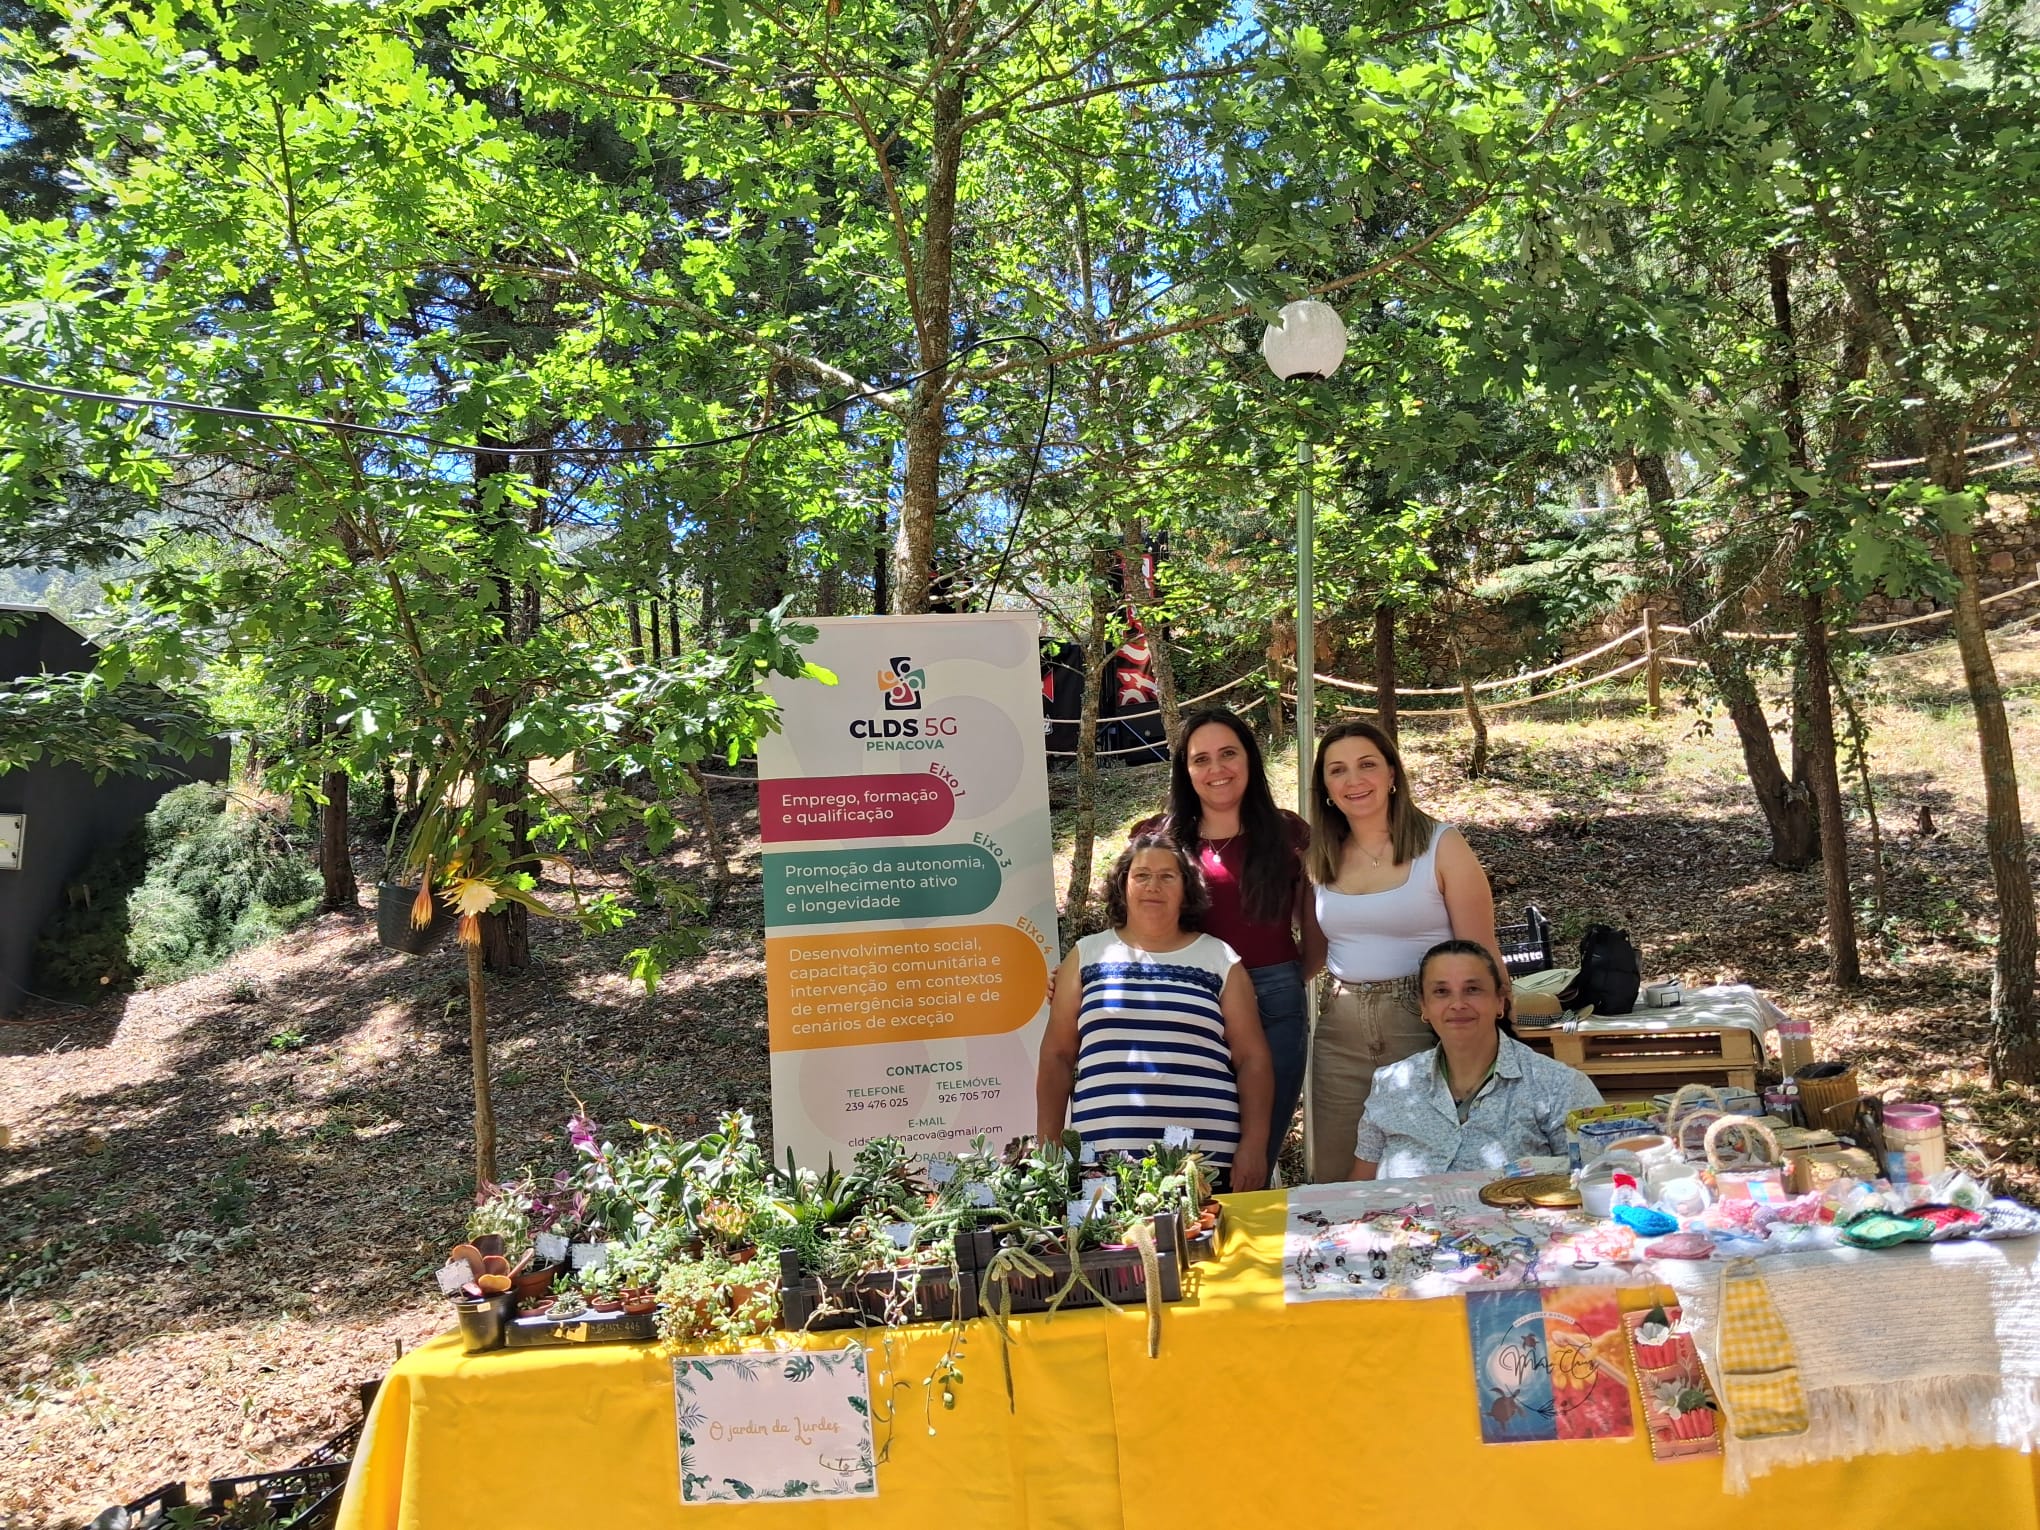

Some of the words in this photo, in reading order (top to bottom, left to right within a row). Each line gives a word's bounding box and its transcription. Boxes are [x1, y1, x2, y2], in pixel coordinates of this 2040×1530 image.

[850, 719, 918, 738] CLDS
[925, 717, 958, 736] 5G
[866, 739, 944, 752] PENACOVA
[929, 762, 959, 788] Eixo
[955, 790, 966, 798] 1
[782, 792, 860, 808] Emprego,
[864, 788, 938, 804] formação
[782, 814, 792, 824] e
[796, 807, 894, 826] qualificação
[973, 832, 1003, 857] Eixo
[1001, 858, 1012, 869] 3
[785, 862, 868, 880] Promoção
[873, 861, 892, 874] da
[897, 855, 985, 873] autonomia,
[785, 875, 915, 895] envelhecimento
[920, 874, 958, 888] ativo
[786, 903, 796, 913] e
[801, 895, 900, 915] longevidade
[1016, 916, 1045, 944] Eixo
[1044, 945, 1054, 955] 4
[789, 941, 930, 962] Desenvolvimento
[934, 936, 982, 953] social,
[789, 961, 888, 982] capacitação
[892, 954, 987, 973] comunitária
[991, 956, 1001, 967] e
[790, 978, 887, 998] intervenção
[896, 979, 921, 991] em
[926, 972, 1003, 988] contextos
[791, 1002, 812, 1017] de
[817, 994, 913, 1016] emergência
[918, 991, 961, 1008] social
[966, 993, 976, 1004] e
[980, 988, 1000, 1002] de
[792, 1016, 861, 1035] cenários
[866, 1014, 886, 1029] de
[890, 1010, 954, 1028] exceção
[886, 1061, 963, 1077] CONTACTOS
[847, 1084, 905, 1098] TELEFONE
[936, 1076, 1002, 1091] TELEMÓVEL
[845, 1100, 864, 1112] 239
[868, 1099, 887, 1111] 476
[889, 1098, 909, 1110] 025
[938, 1092, 957, 1103] 926
[961, 1091, 980, 1102] 705
[982, 1089, 1001, 1101] 707
[908, 1116, 946, 1128] E-MAIL
[913, 1151, 955, 1164] ORADA
[709, 1421, 724, 1441] O
[727, 1420, 768, 1442] jardim
[772, 1419, 790, 1433] da
[794, 1416, 841, 1446] Lurdes
